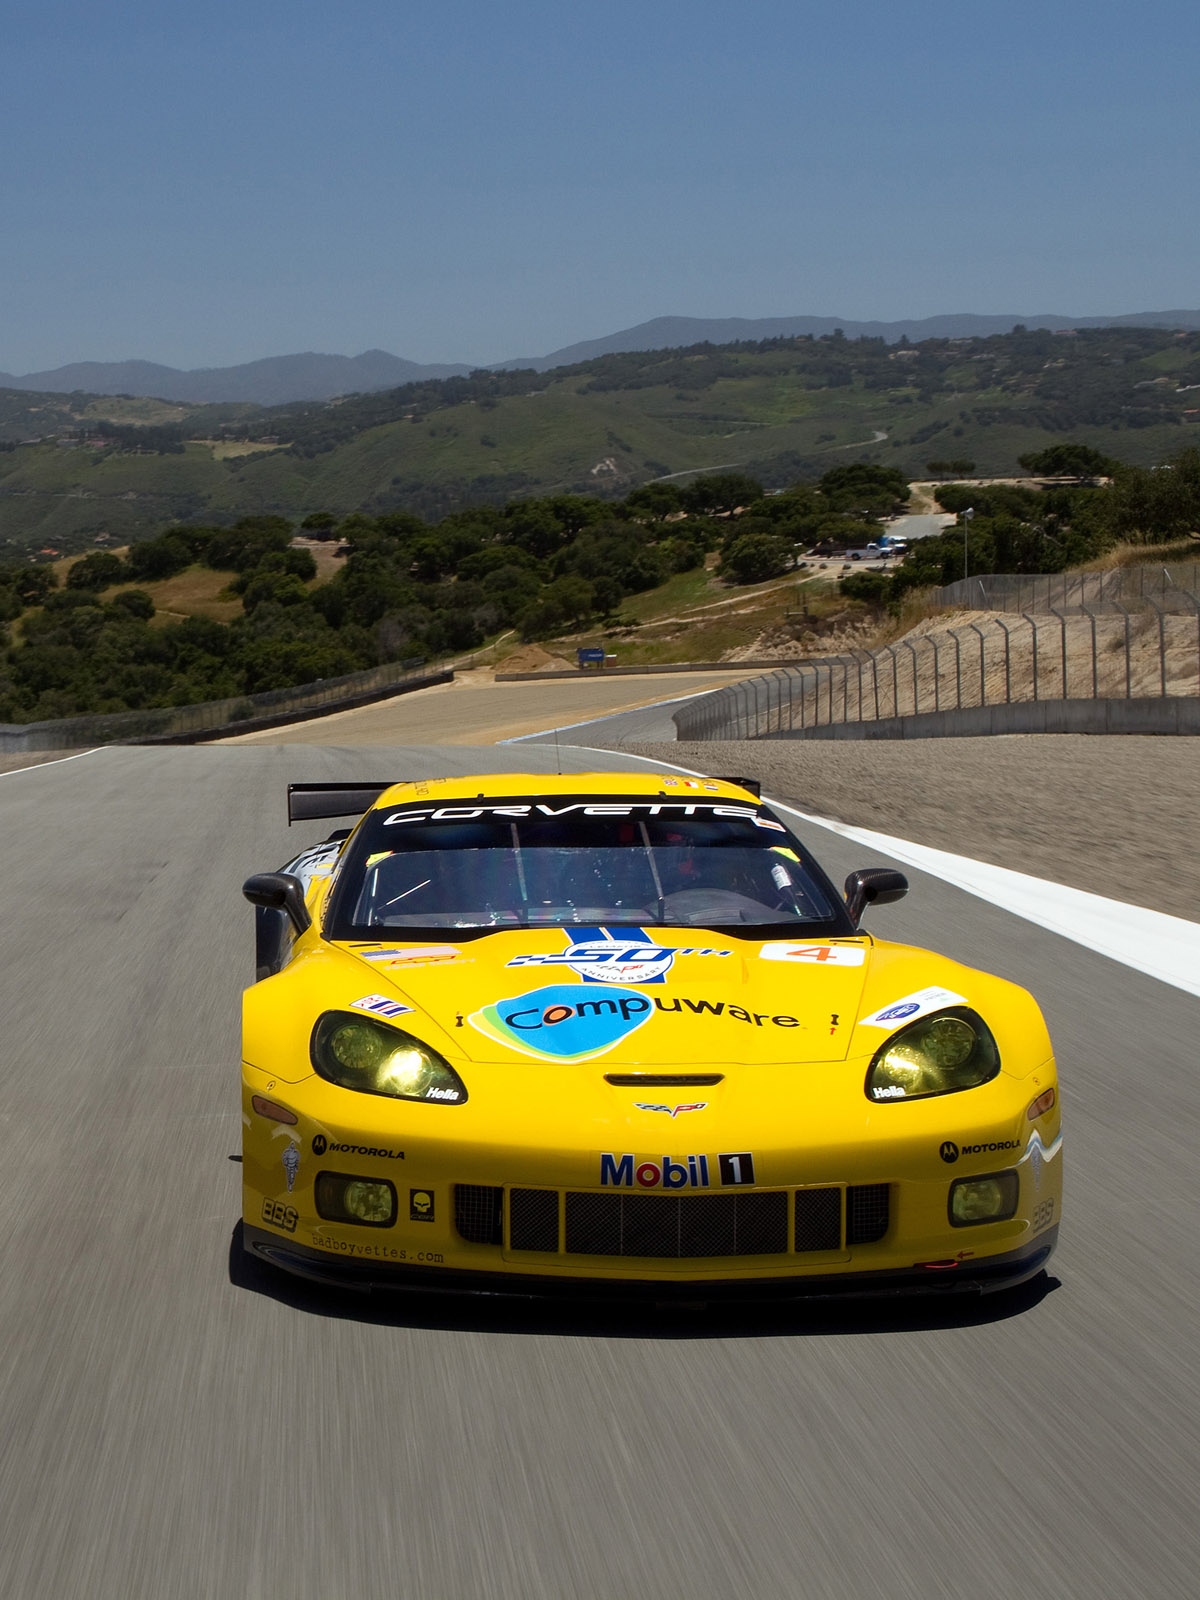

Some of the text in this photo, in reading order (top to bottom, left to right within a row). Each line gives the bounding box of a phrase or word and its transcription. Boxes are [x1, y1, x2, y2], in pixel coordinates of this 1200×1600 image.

[383, 803, 757, 826] CORVETTE
[786, 946, 837, 962] 4
[582, 966, 661, 981] ANNIVERSARY
[505, 997, 801, 1030] Compuware
[425, 1086, 460, 1100] Hella
[872, 1085, 906, 1099] Hella
[329, 1143, 405, 1160] MOTOROLA
[961, 1140, 1021, 1155] MOTOROLA
[600, 1152, 710, 1188] Mobil
[261, 1197, 299, 1233] BBS
[312, 1234, 445, 1264] badboyvettes.com
